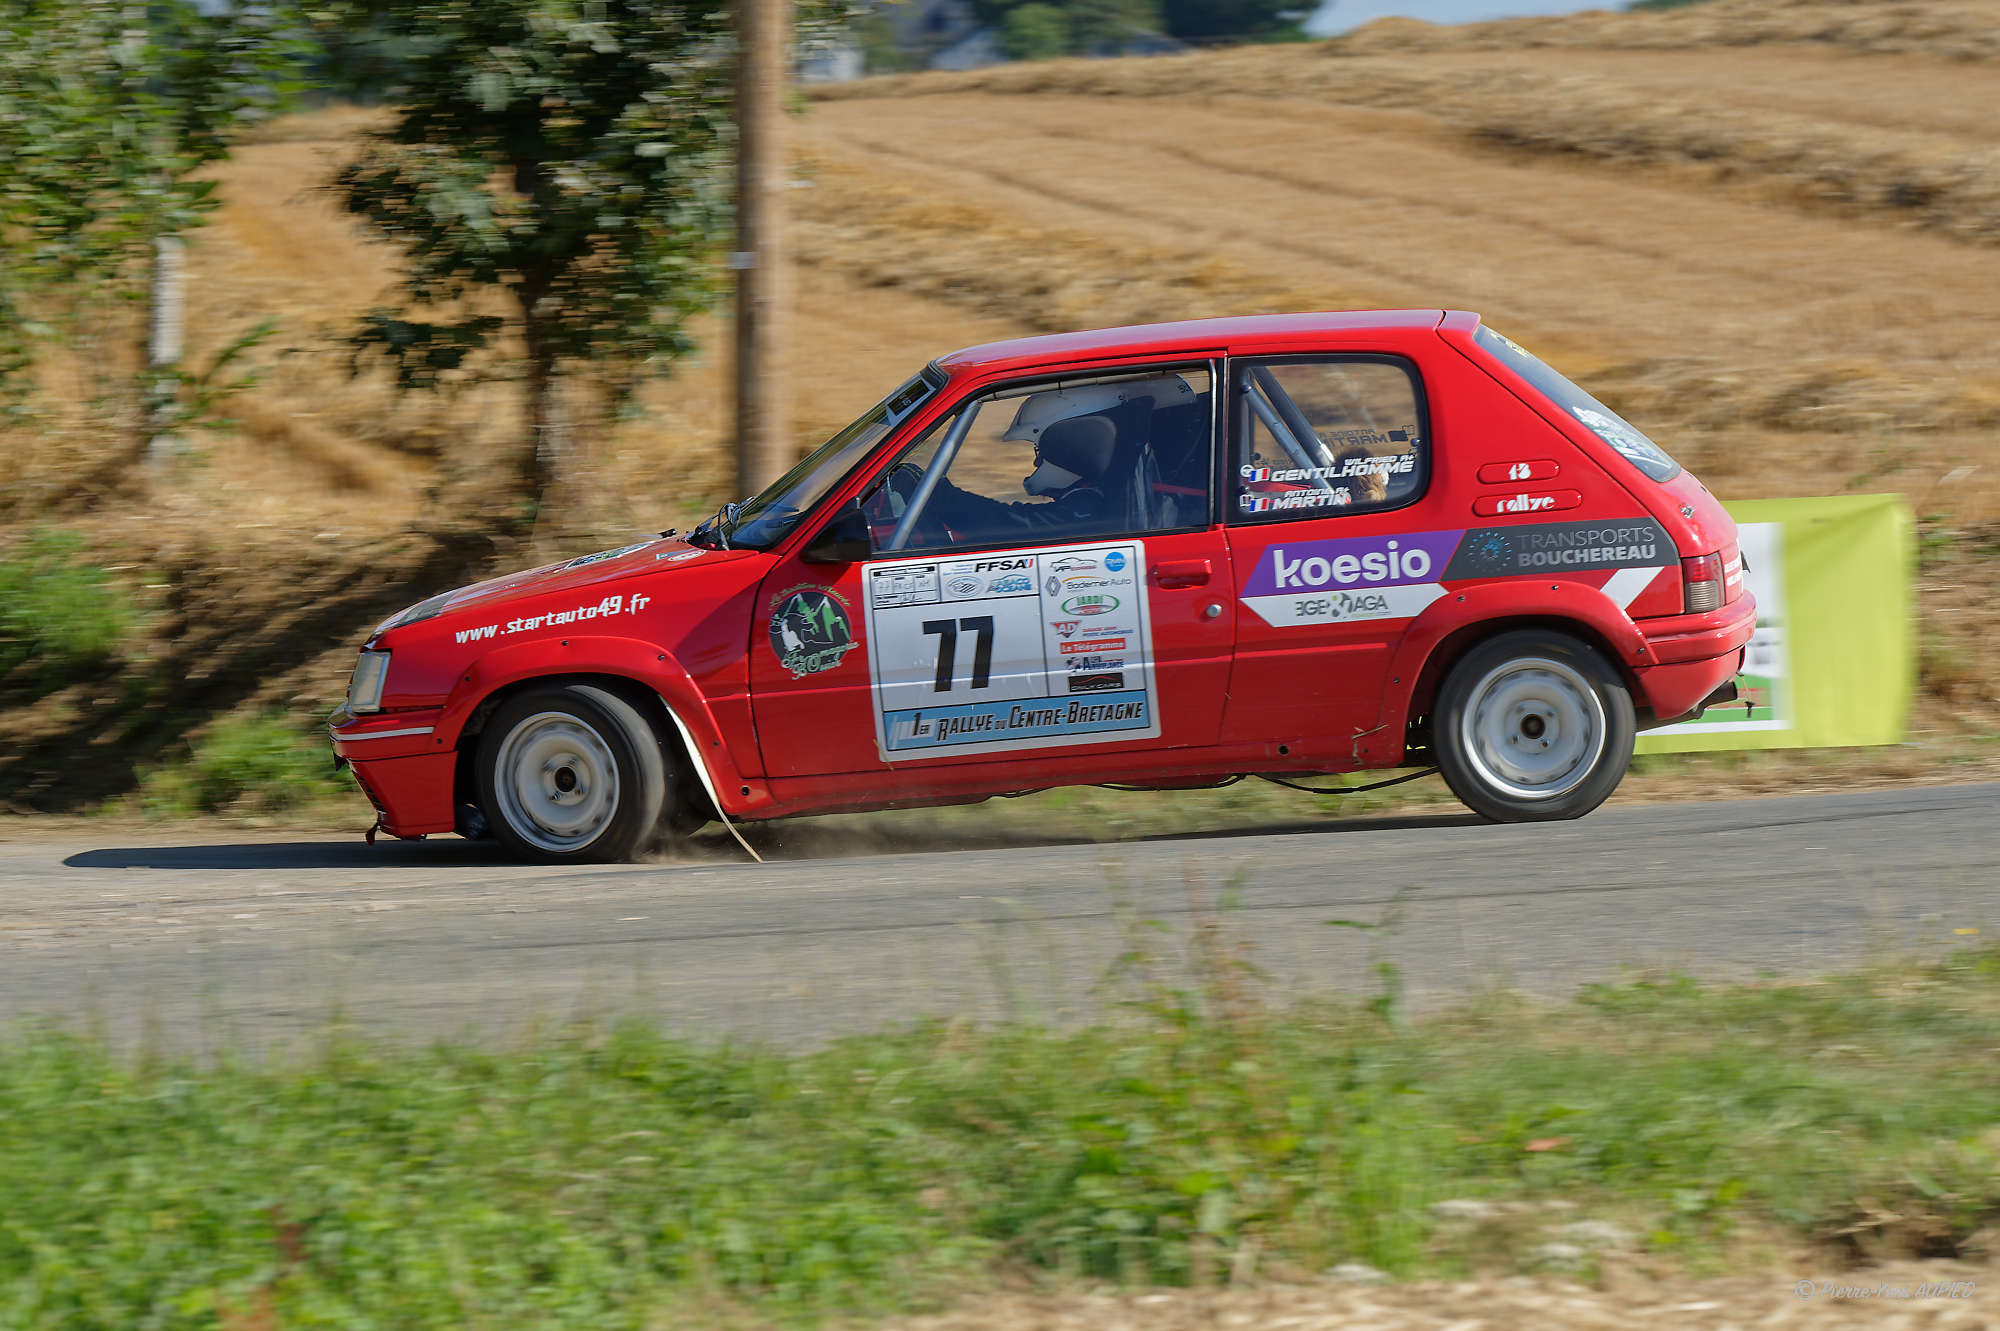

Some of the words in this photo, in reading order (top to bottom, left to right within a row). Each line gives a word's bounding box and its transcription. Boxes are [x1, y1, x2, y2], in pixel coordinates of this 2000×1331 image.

[1271, 460, 1415, 481] GENTILHOMME
[1344, 455, 1397, 466] WILFRIED
[1272, 493, 1349, 510] MARTIN
[1497, 494, 1555, 512] rallye
[1516, 526, 1655, 550] TRANSPORTS
[974, 559, 1027, 573] FFSA
[1273, 540, 1431, 588] koesio
[1518, 544, 1656, 567] BOUCHEREAU
[1058, 623, 1076, 633] AD
[921, 615, 994, 692] 77
[936, 713, 994, 742] RALLYE
[1008, 701, 1144, 729] CENTRE-BRETAGNE
